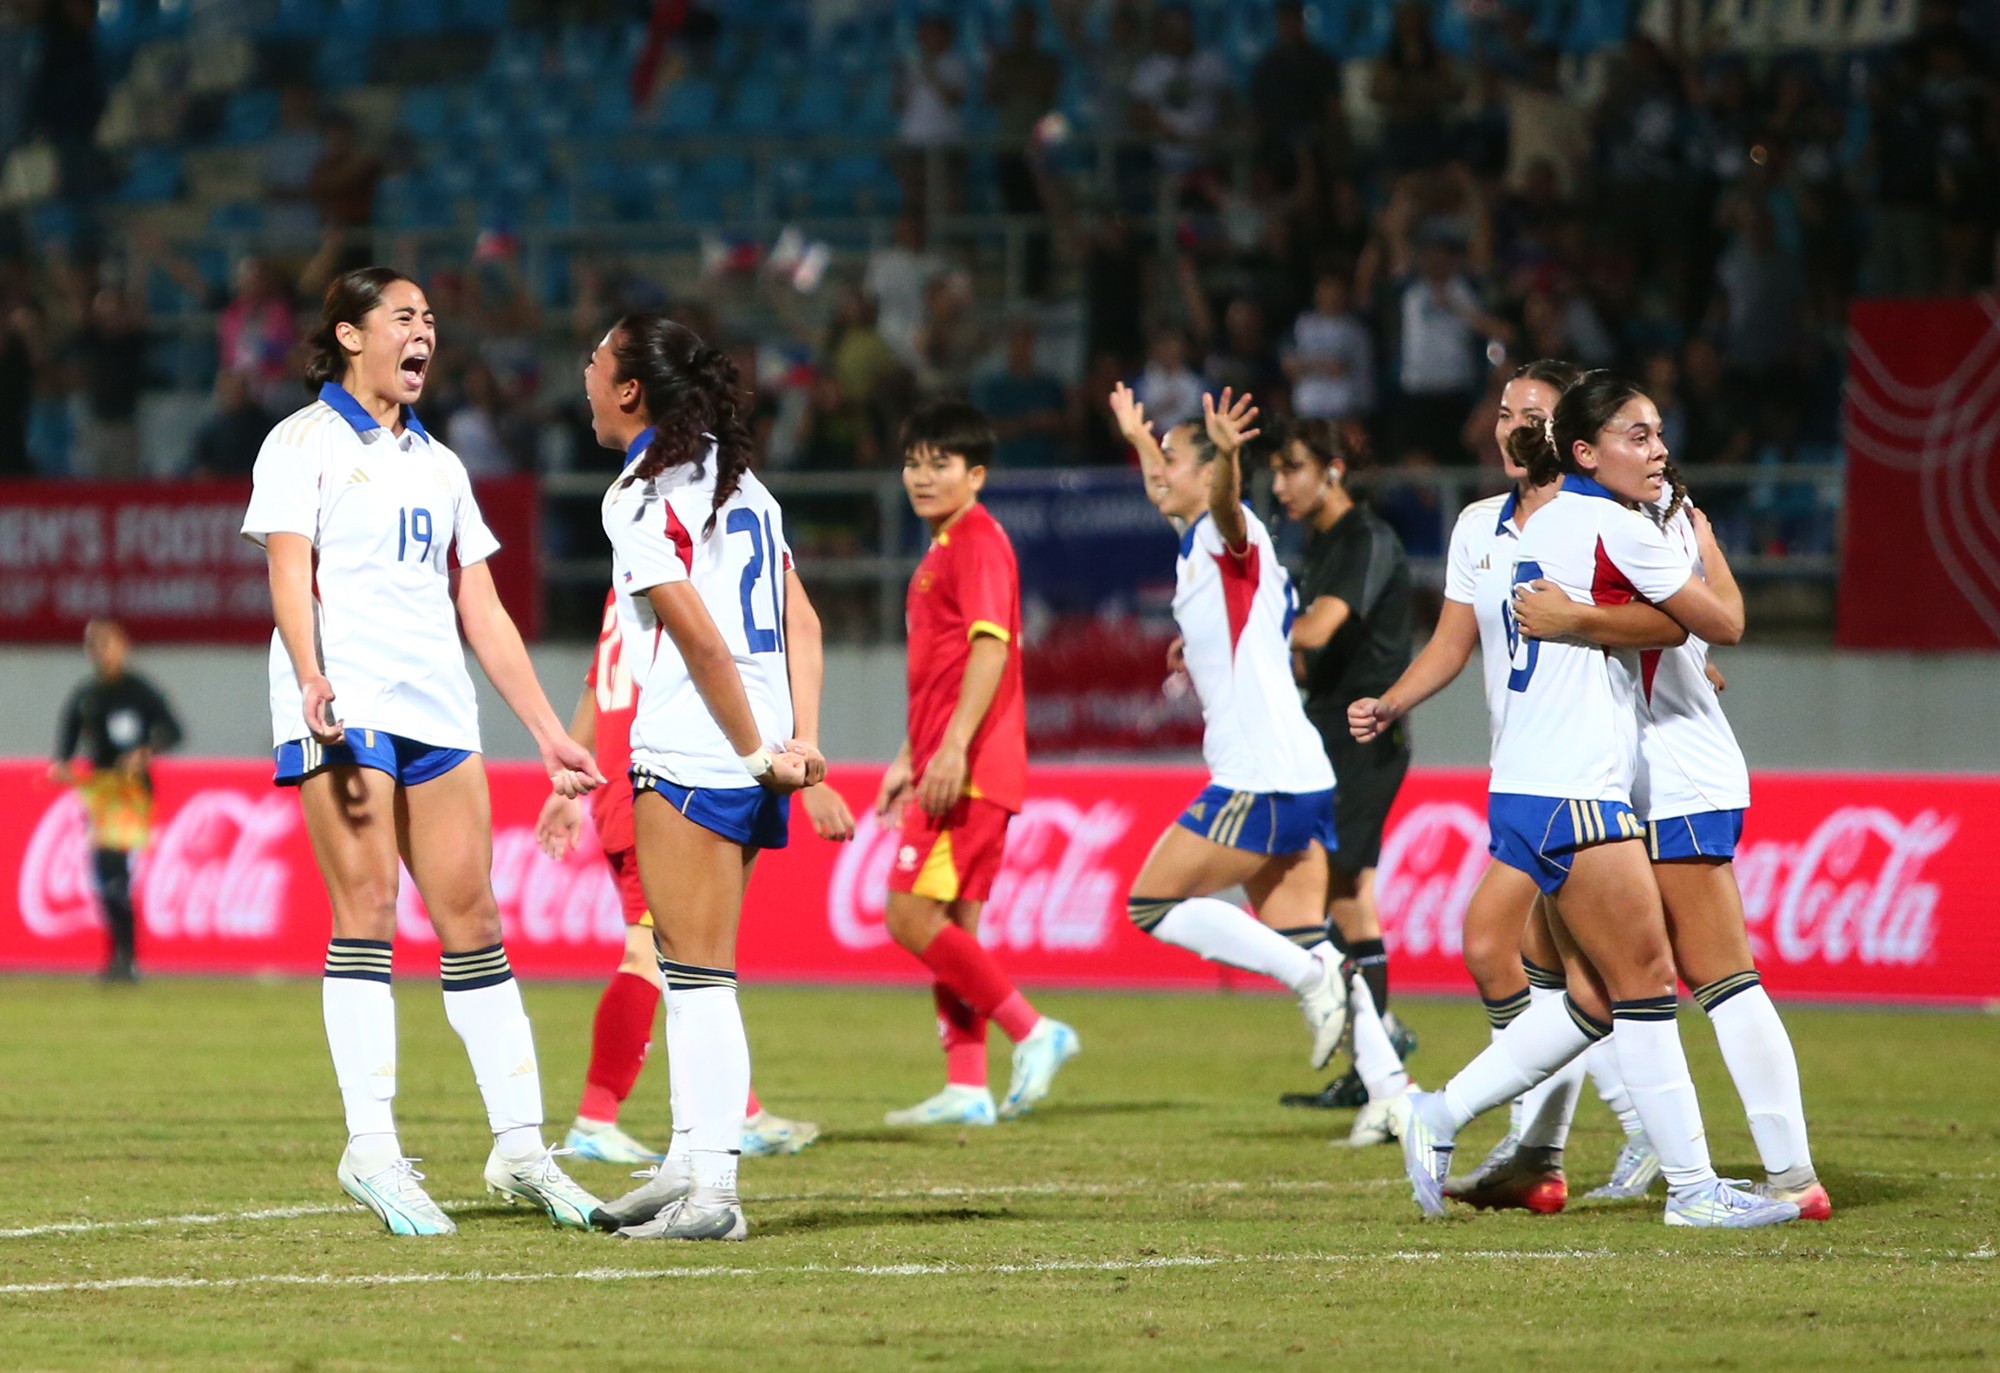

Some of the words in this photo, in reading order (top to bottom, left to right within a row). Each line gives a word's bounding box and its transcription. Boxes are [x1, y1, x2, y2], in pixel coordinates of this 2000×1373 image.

[398, 507, 432, 563] 19
[726, 507, 783, 654] 21
[18, 789, 300, 938] C-Cola
[827, 797, 1136, 950] CCola
